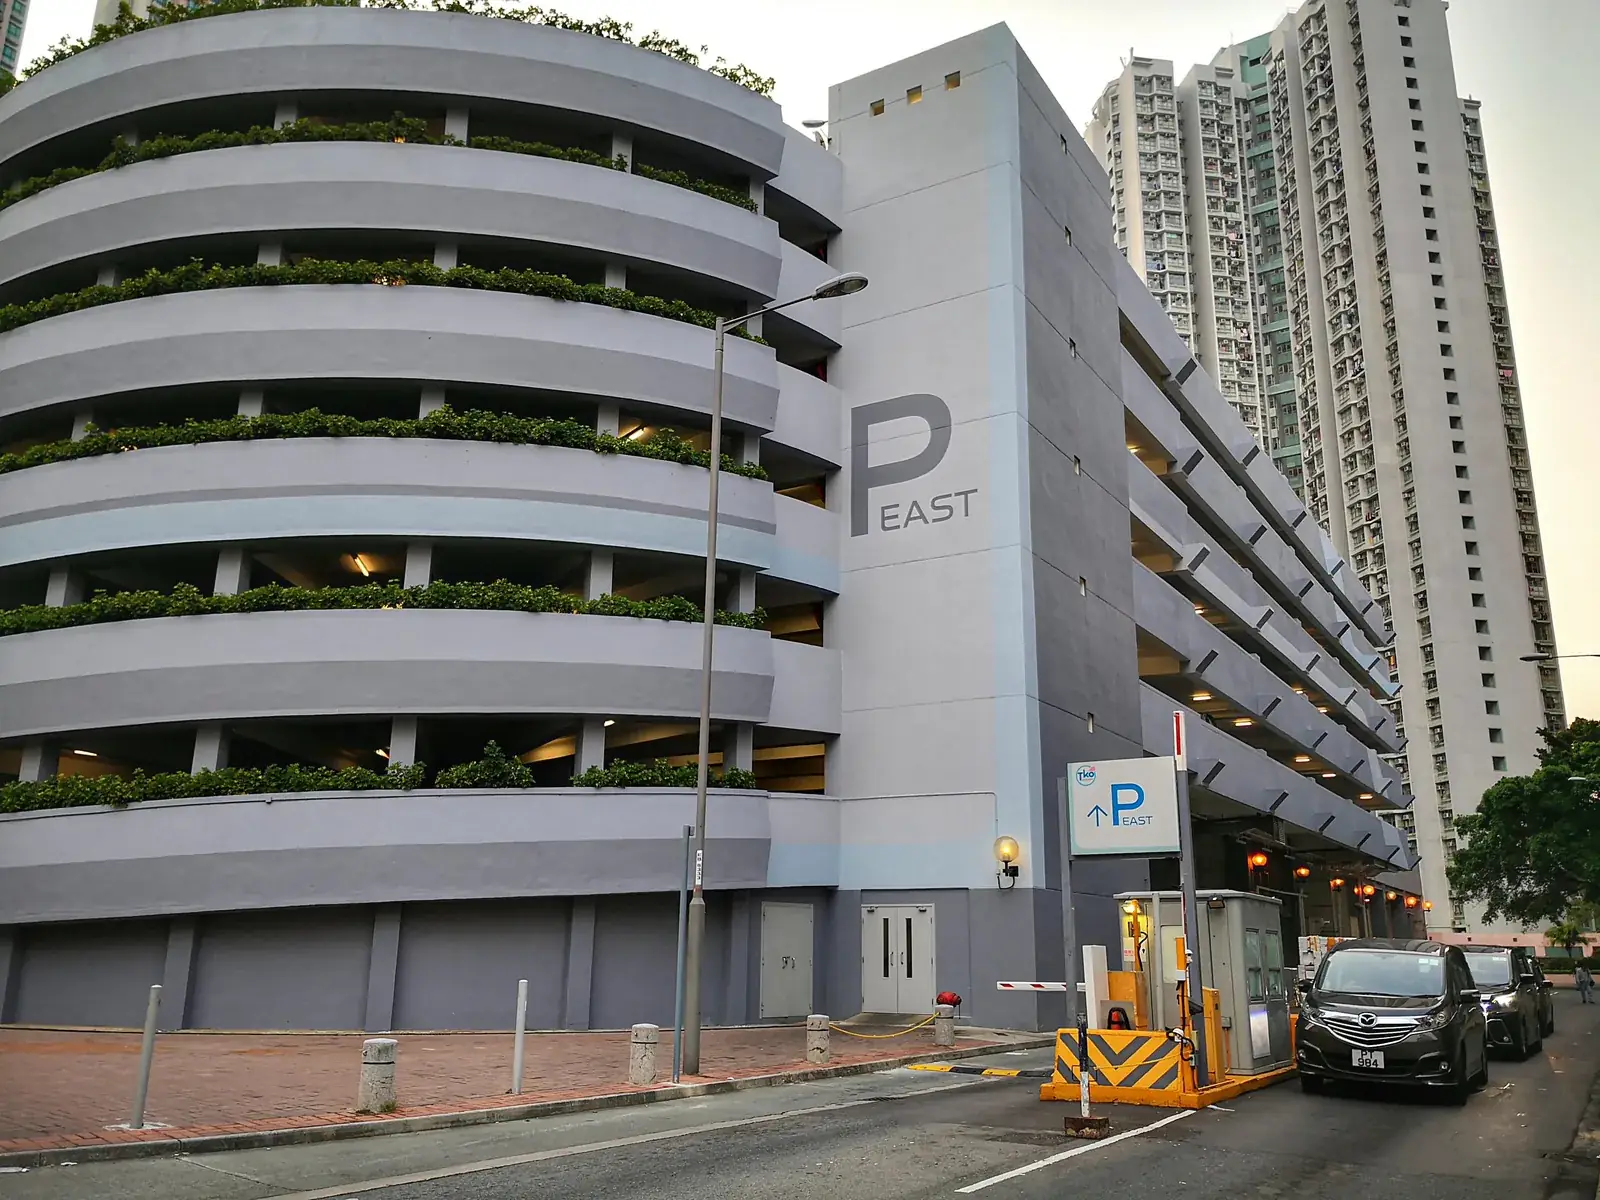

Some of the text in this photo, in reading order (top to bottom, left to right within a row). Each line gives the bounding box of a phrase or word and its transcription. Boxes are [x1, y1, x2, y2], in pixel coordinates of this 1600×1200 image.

[851, 394, 978, 537] P EAST
[1111, 783, 1153, 826] P EAST
[1358, 1058, 1379, 1068] 984
